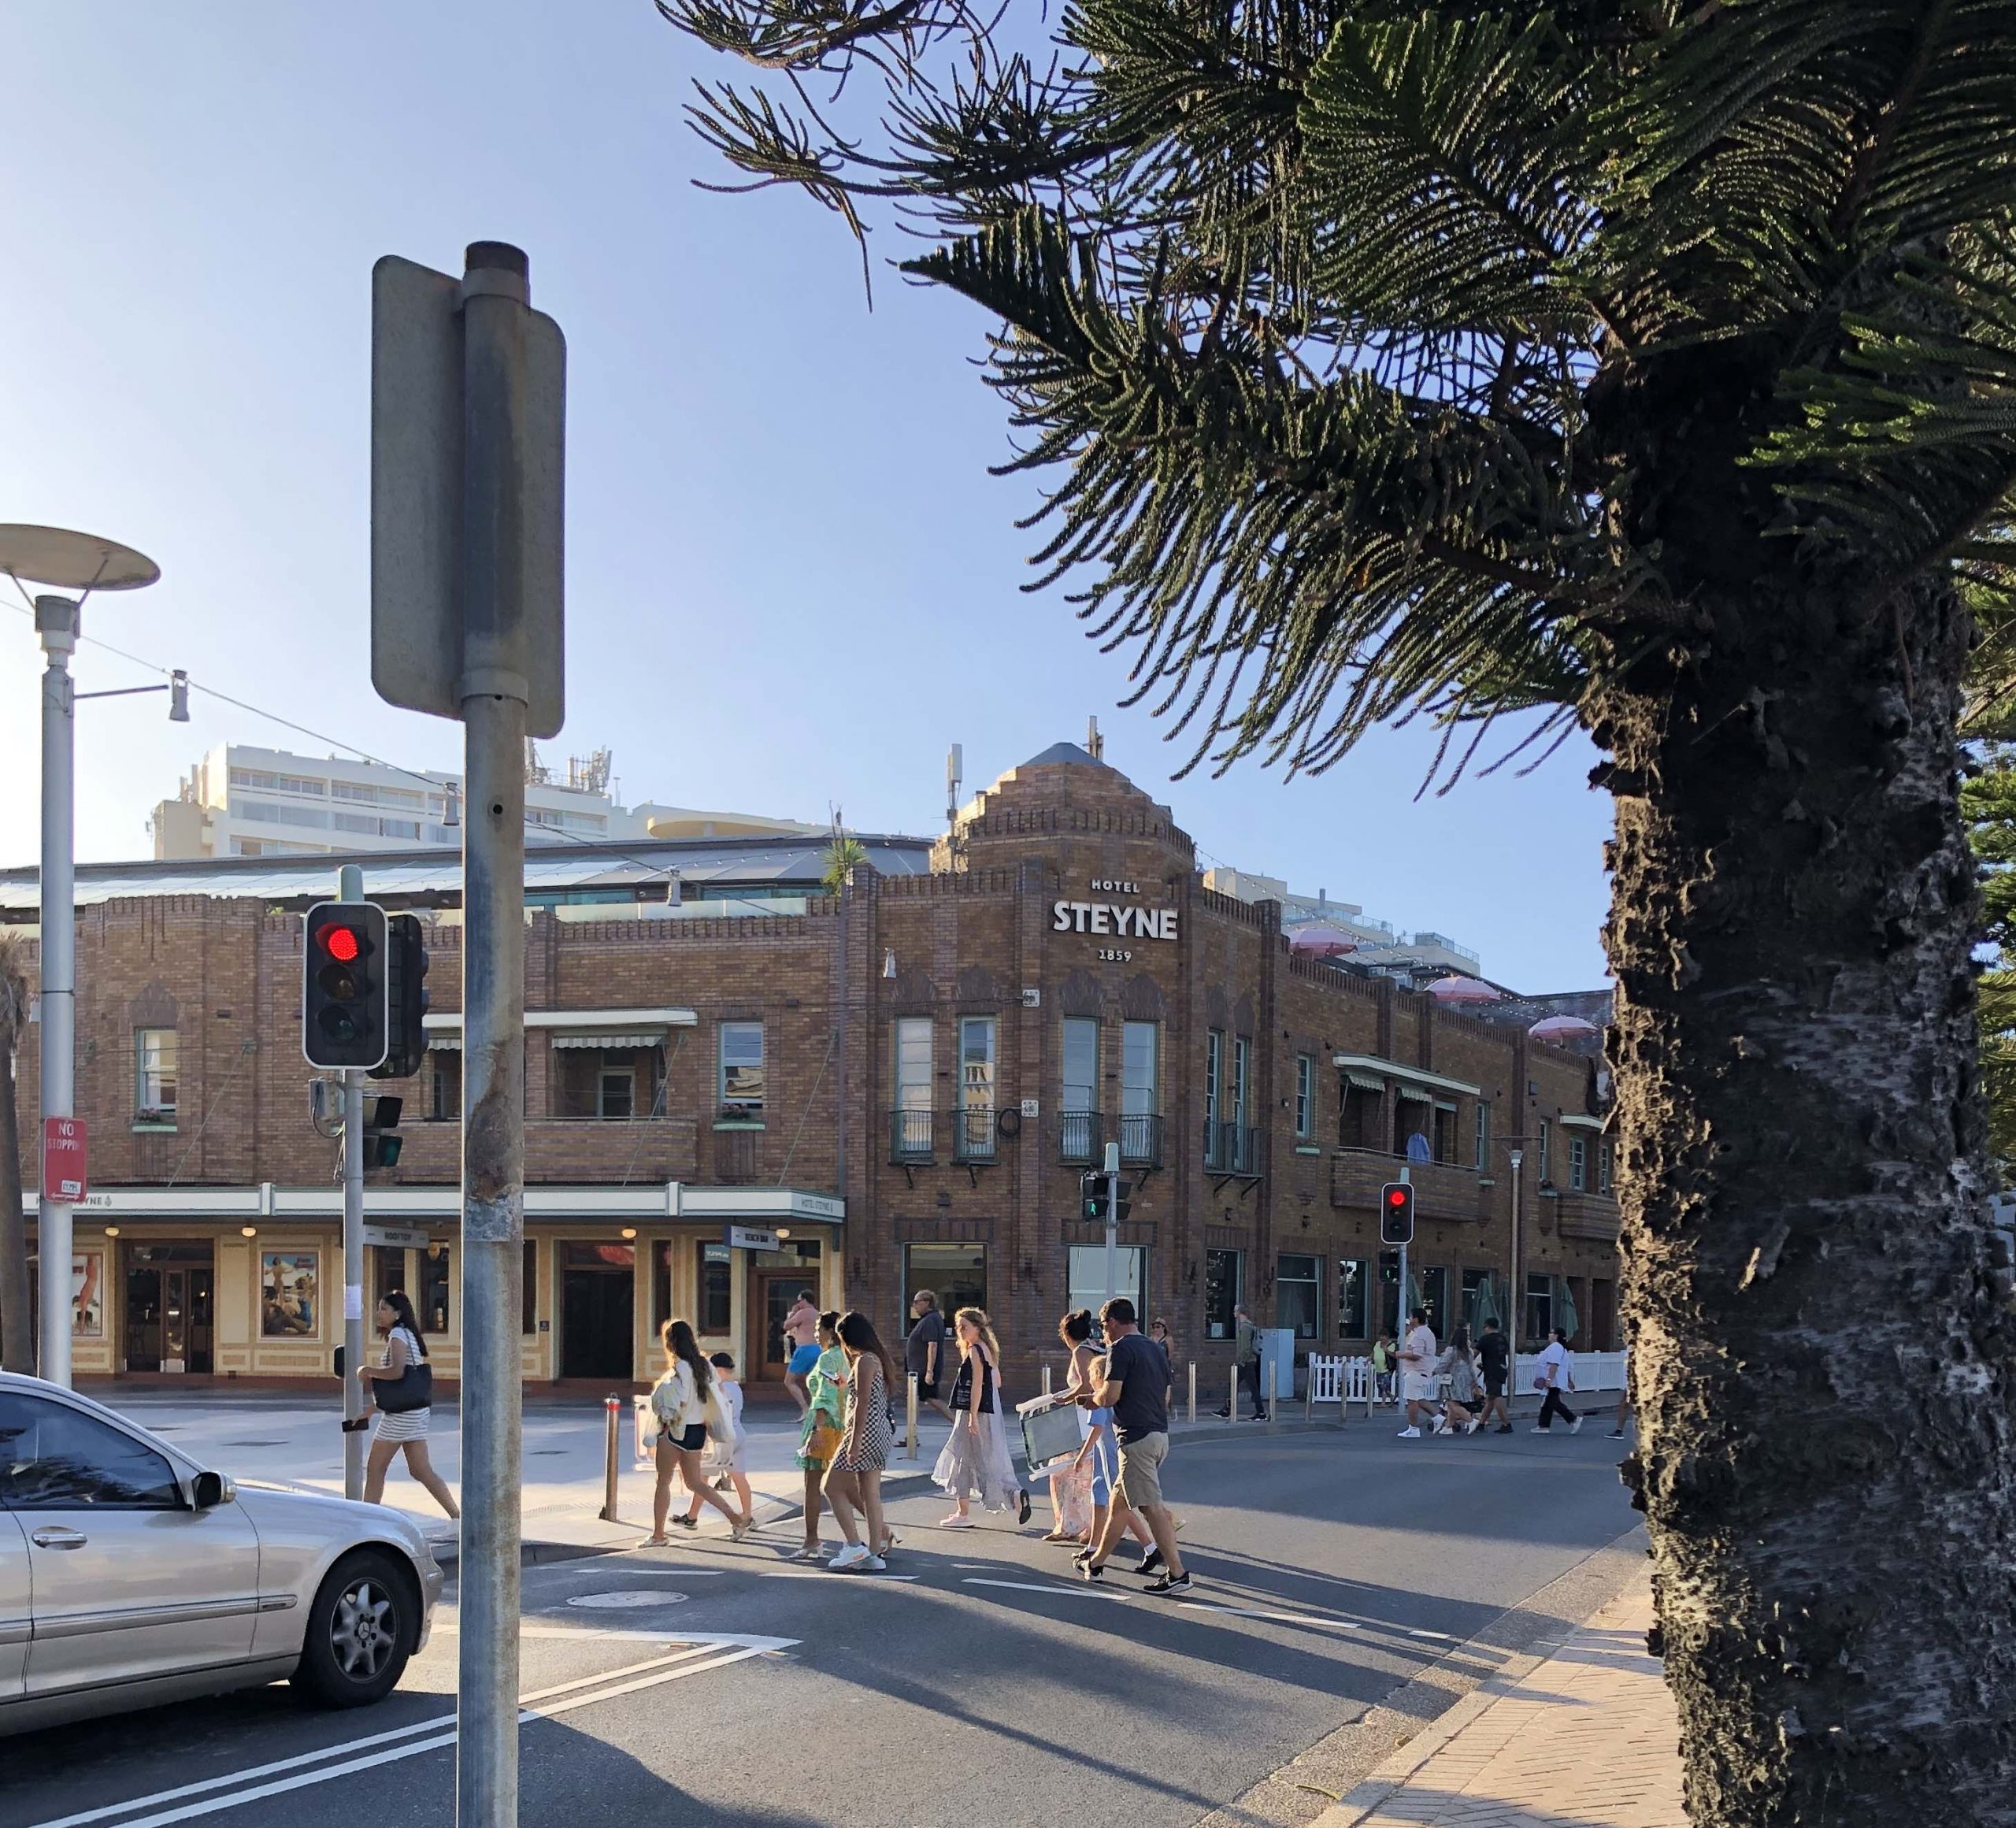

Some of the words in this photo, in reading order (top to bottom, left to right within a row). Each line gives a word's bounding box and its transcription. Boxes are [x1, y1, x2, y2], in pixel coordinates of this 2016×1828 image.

[1091, 879, 1140, 893] HOTEL
[1053, 900, 1178, 940] STEYNE
[1099, 949, 1132, 962] 1859
[58, 1123, 74, 1136] NO
[47, 1138, 81, 1151] STOPPIN
[384, 1231, 411, 1242] ROOFTOP
